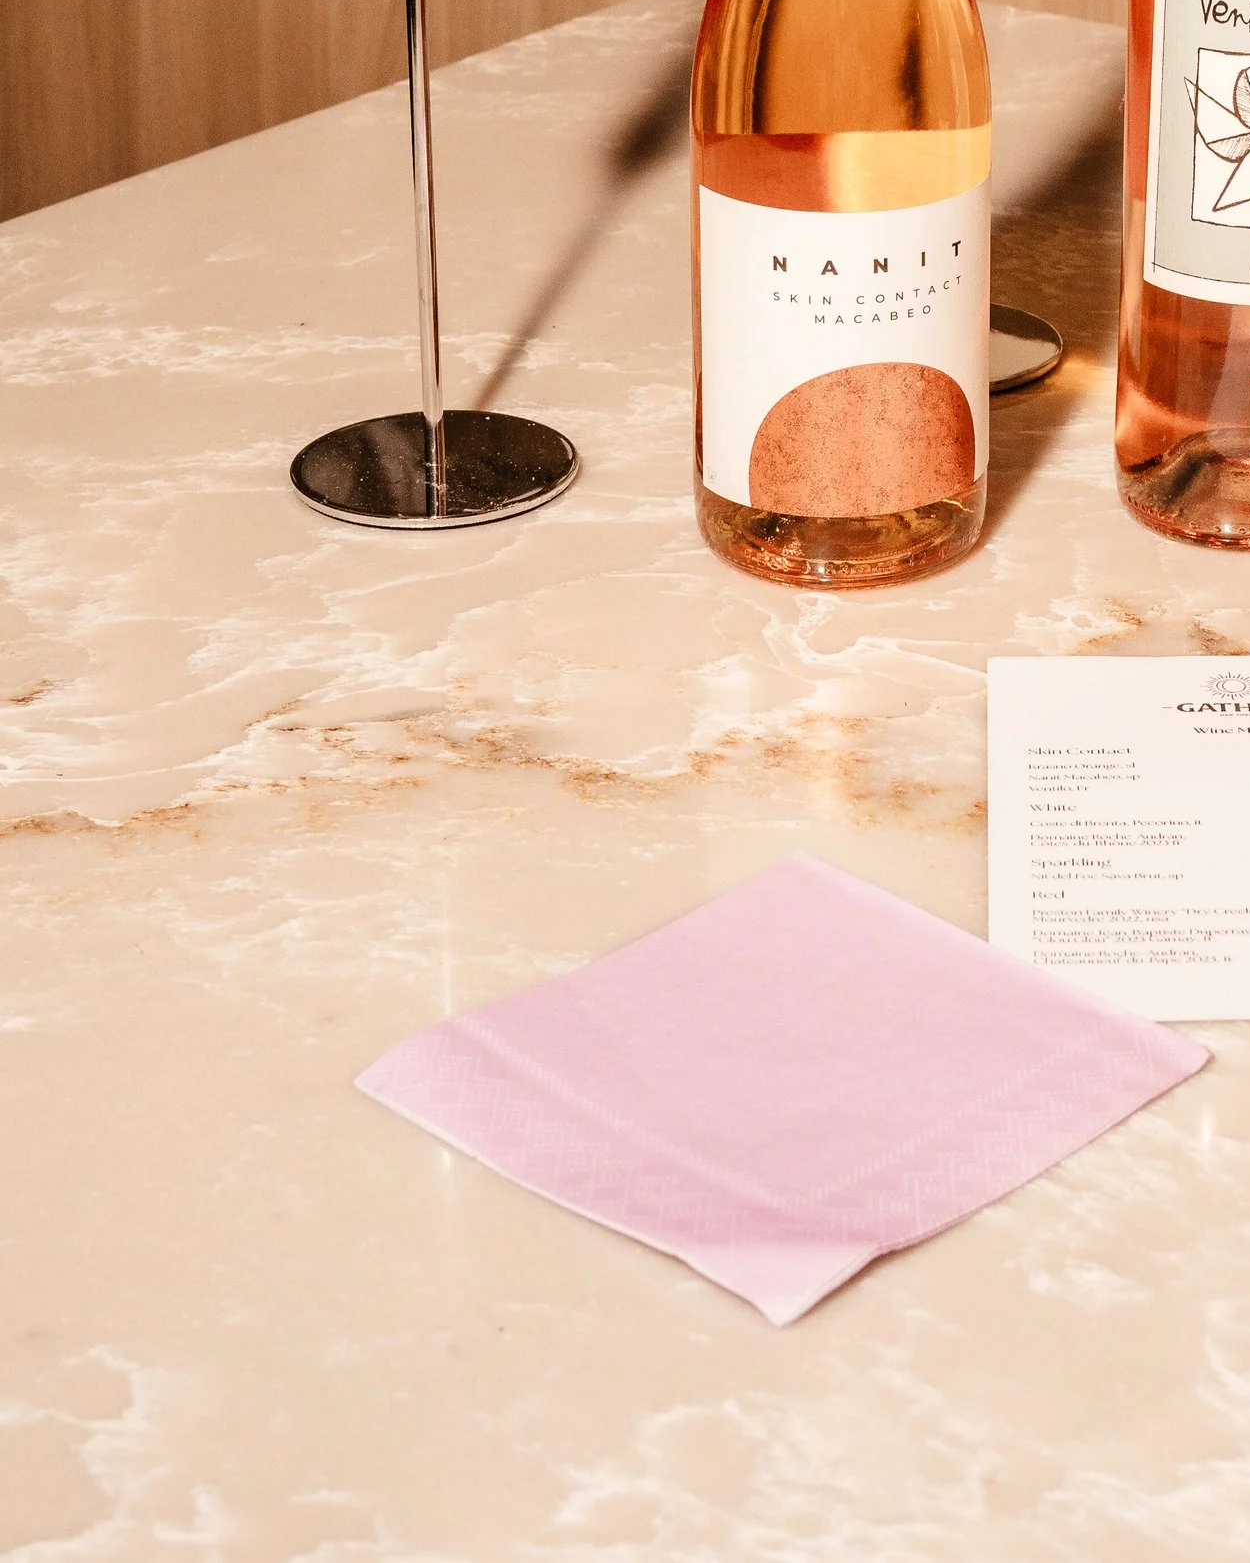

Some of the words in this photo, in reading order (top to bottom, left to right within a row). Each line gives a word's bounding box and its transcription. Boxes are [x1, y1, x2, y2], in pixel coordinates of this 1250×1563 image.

[772, 240, 962, 275] NANIT
[773, 291, 832, 306] SKIN
[856, 275, 962, 306] CONTACT
[814, 304, 932, 325] MACABEO
[1028, 747, 1062, 755] Skin
[1066, 747, 1133, 755] Contact
[1029, 803, 1078, 812] White
[1031, 858, 1111, 869] Sparkling
[1032, 890, 1065, 900] Red
